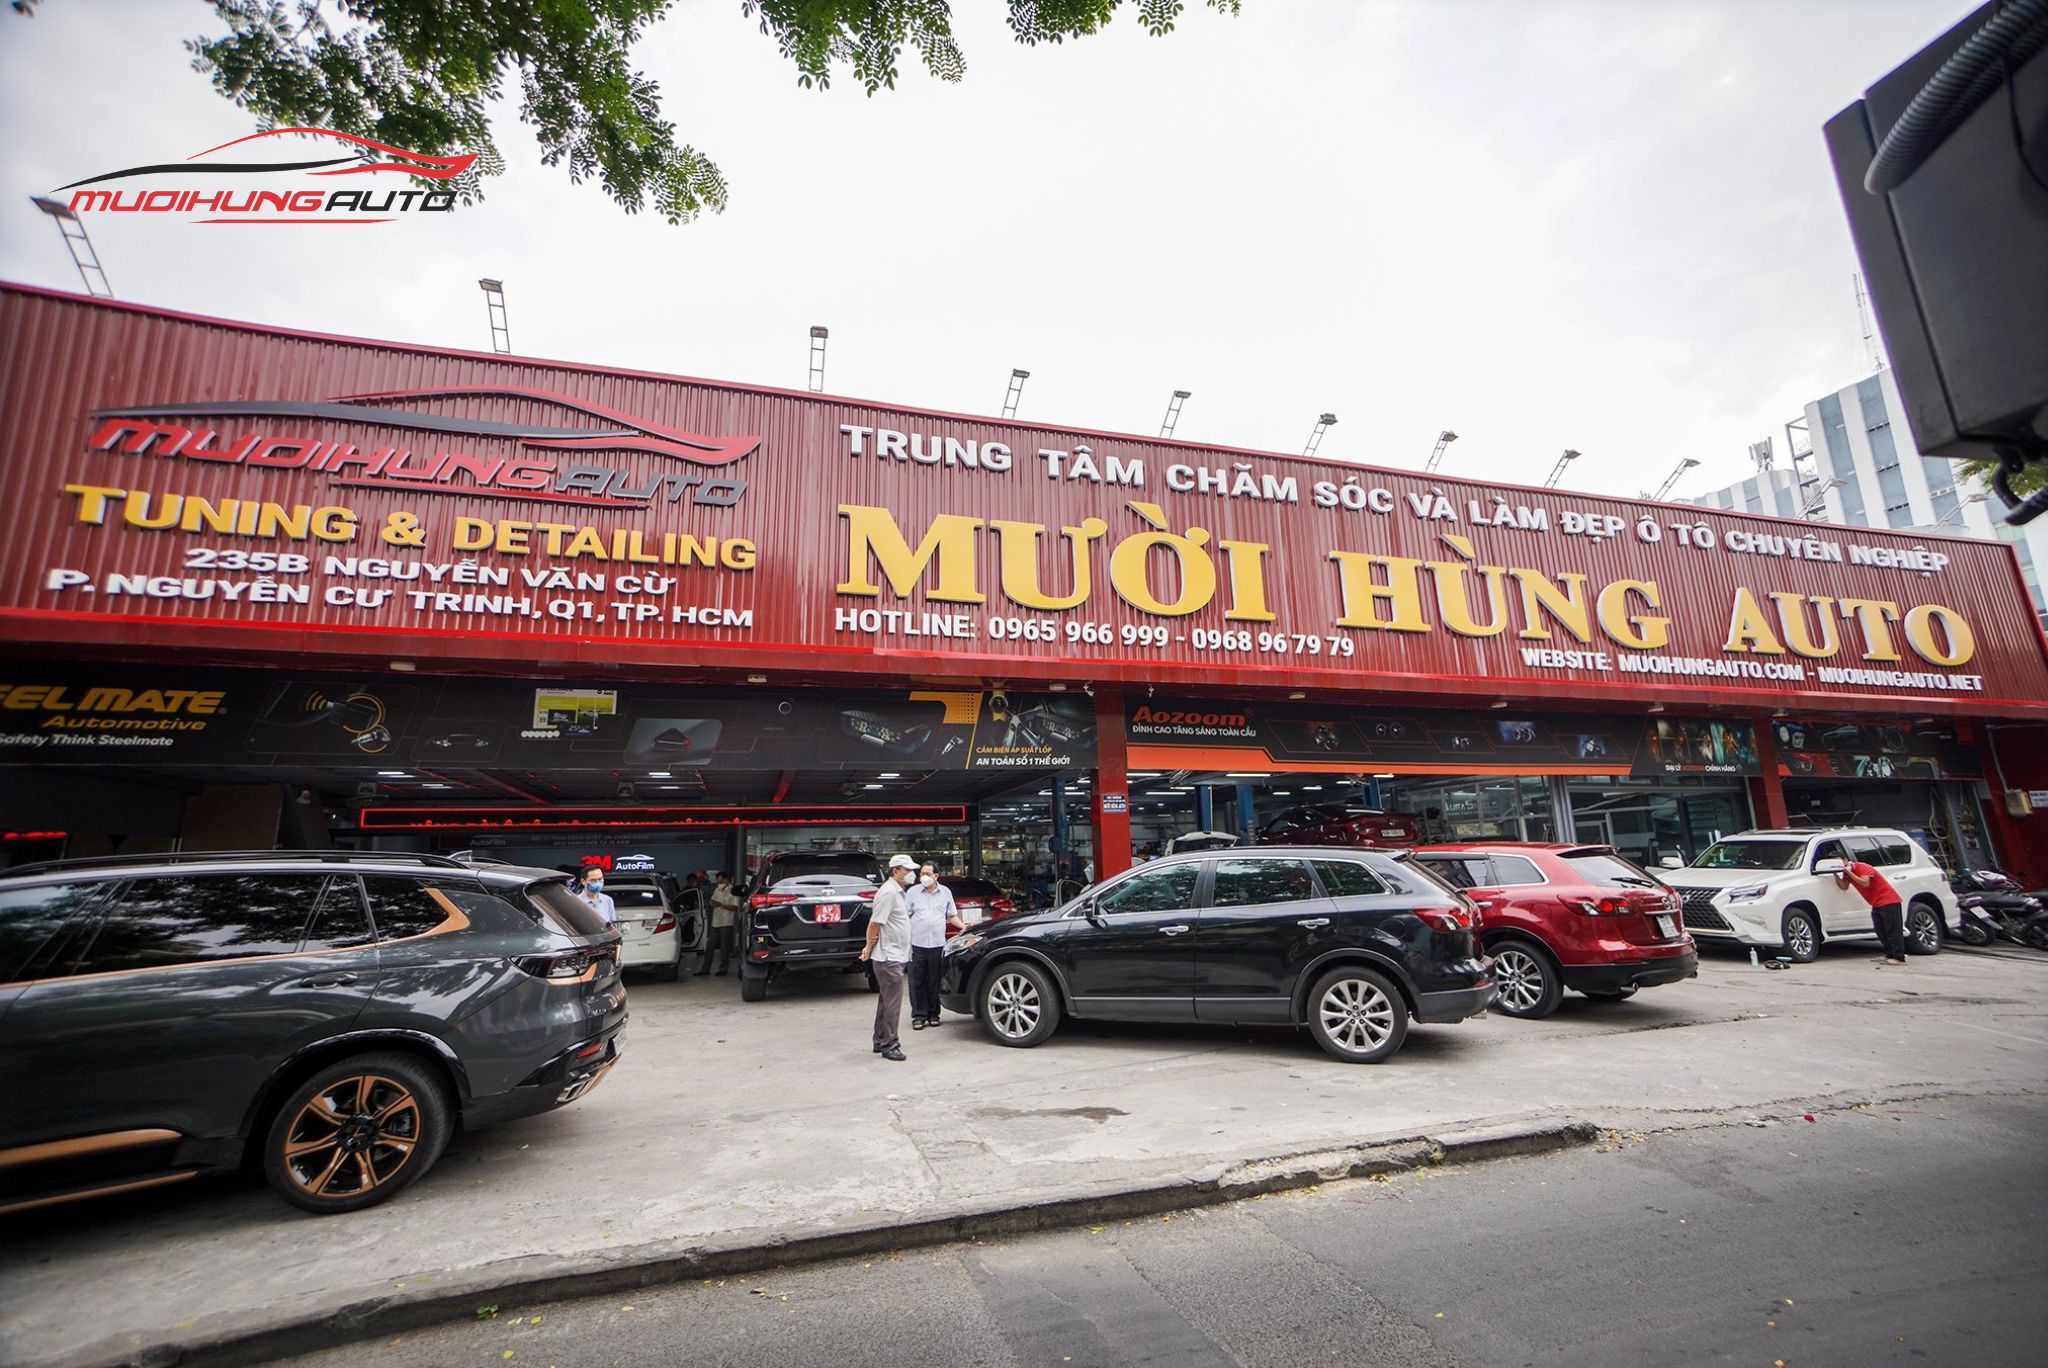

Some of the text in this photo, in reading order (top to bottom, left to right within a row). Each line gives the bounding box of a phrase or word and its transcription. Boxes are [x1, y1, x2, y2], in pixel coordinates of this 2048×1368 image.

[840, 424, 1949, 578] TRUNG TÂM CHĂM SÓC VÀ LÀM ĐẸP Ô TÔ CHUYÊN NGHIỆP
[66, 483, 757, 571] TUNING & DETAILING
[185, 548, 677, 594] 235B NGUYỄN VĂN CỪ
[836, 500, 1976, 666] MƯỜI HÙNG AUTO
[48, 569, 95, 592] P.
[107, 573, 310, 604] NGUYỄN
[325, 586, 393, 607] CƯ
[672, 606, 752, 626] HCM
[835, 607, 976, 638] HOTLINE:
[988, 616, 1057, 641] 0965
[1065, 621, 1113, 645] 966
[1121, 624, 1169, 647] 999
[1192, 628, 1253, 652] 0968
[1520, 648, 1612, 671] WEBSITE:
[1618, 654, 1804, 682] MUOIHUNGAUTO.COM
[1817, 666, 1983, 691] MUOIHUNGAUTO.NET
[42, 715, 207, 731] Automotive
[1132, 704, 1246, 727] Aozoom
[1154, 725, 1171, 734] CAO
[52, 733, 96, 745] Think
[98, 734, 174, 746] Steelmate
[976, 757, 990, 766] AN
[991, 756, 1015, 766] TOÀN
[1016, 754, 1028, 766] SỐ
[1034, 754, 1051, 766] THẾ
[616, 861, 654, 870] AutoFilm
